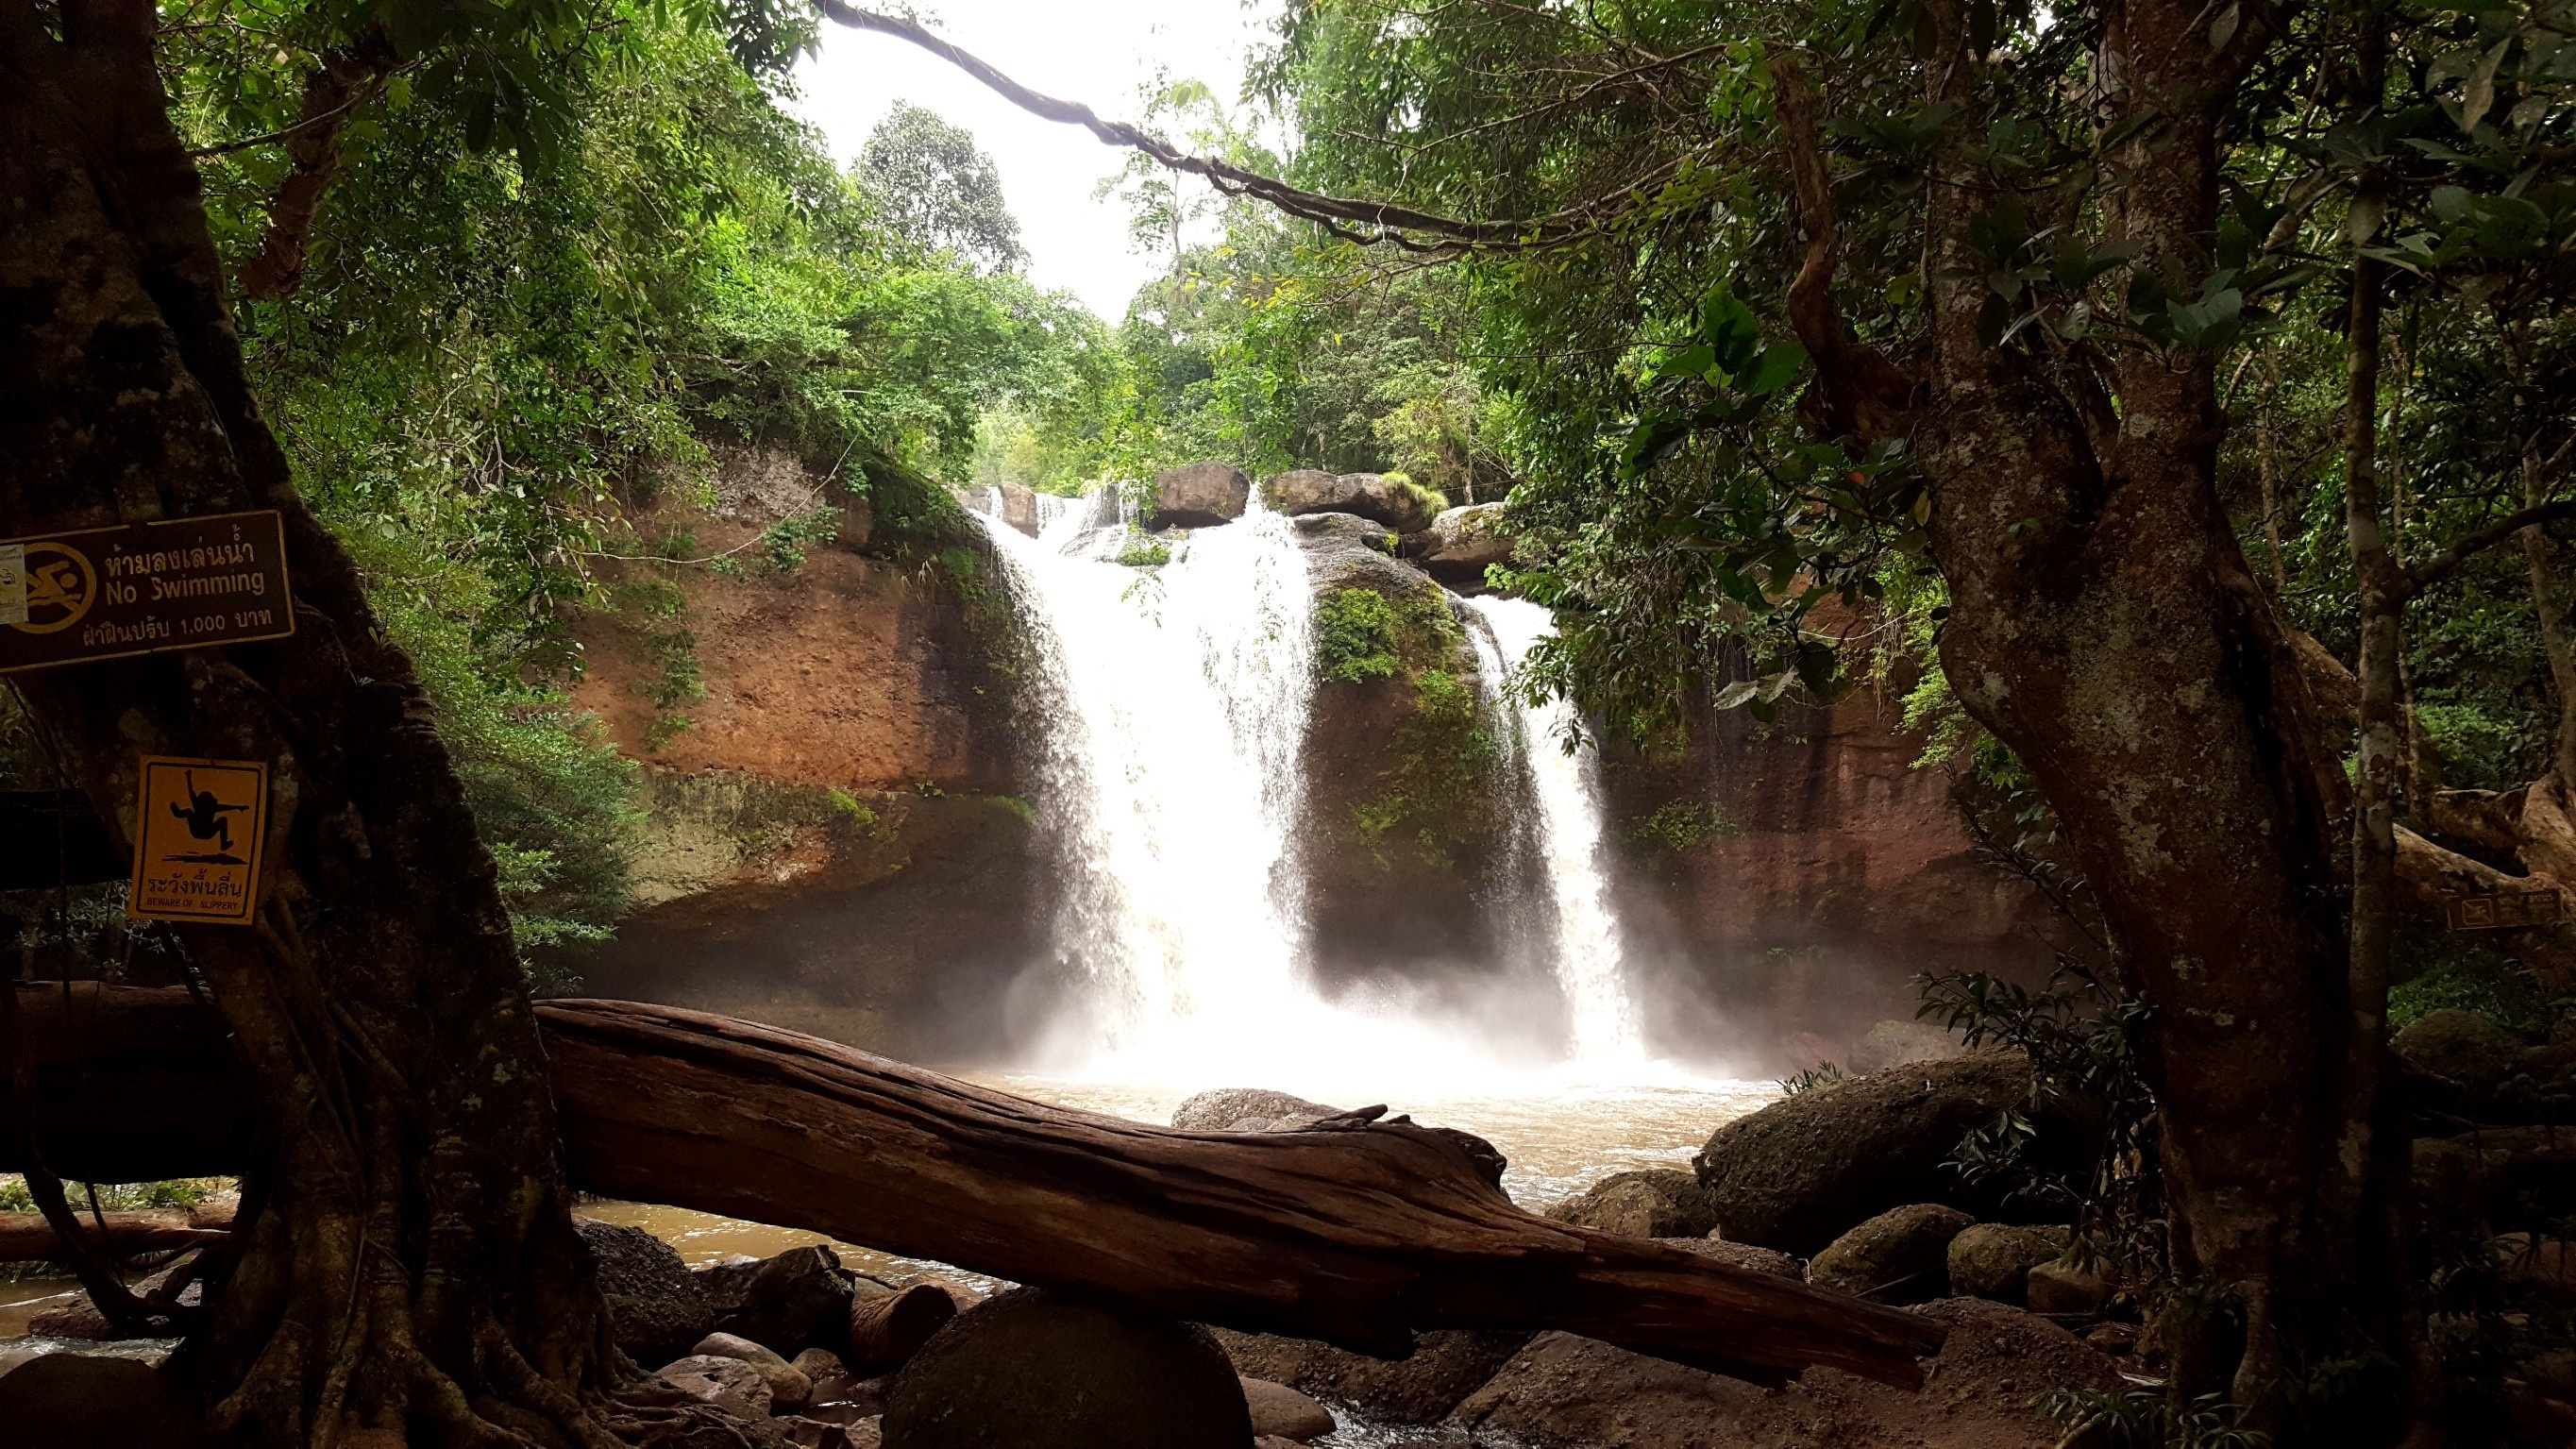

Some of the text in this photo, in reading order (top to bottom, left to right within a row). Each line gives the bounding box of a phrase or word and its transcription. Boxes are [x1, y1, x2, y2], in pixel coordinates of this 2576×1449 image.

[105, 524, 254, 576] ห้ามลงเล่นน้ำ
[106, 569, 265, 605] No Swimming
[180, 615, 226, 635] 1,000
[236, 609, 272, 628] บาท
[148, 868, 242, 897] ระวังพื้นลื่น
[146, 898, 238, 910] BEWARE OF SLIPPERY
